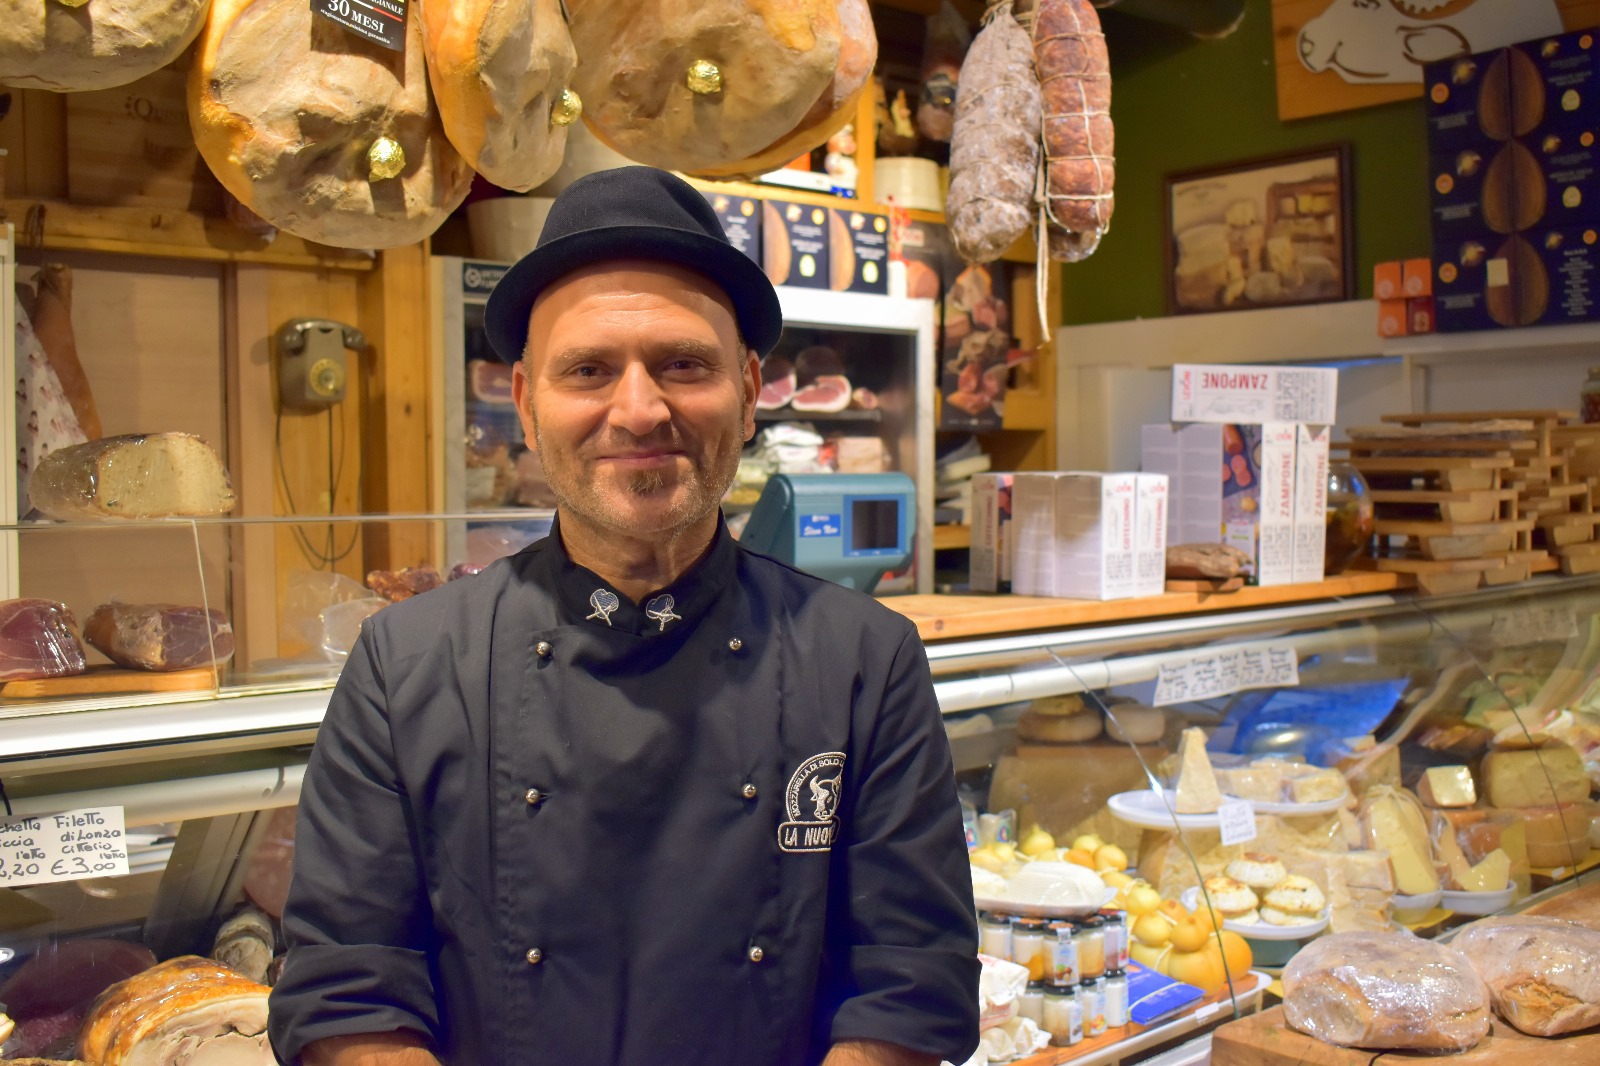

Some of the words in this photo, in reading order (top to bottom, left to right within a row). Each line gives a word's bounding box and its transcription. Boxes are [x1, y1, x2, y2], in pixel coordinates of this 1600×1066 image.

[328, 0, 350, 17] 30
[351, 10, 384, 34] MESI
[1201, 373, 1268, 390] ZAMPONE
[1281, 454, 1290, 517] ZAMPONE
[791, 769, 812, 818] MOZZARELLA
[818, 758, 840, 768] SOLO
[53, 811, 105, 829] Filetto
[784, 827, 798, 846] LA
[50, 856, 116, 875] €3,00
